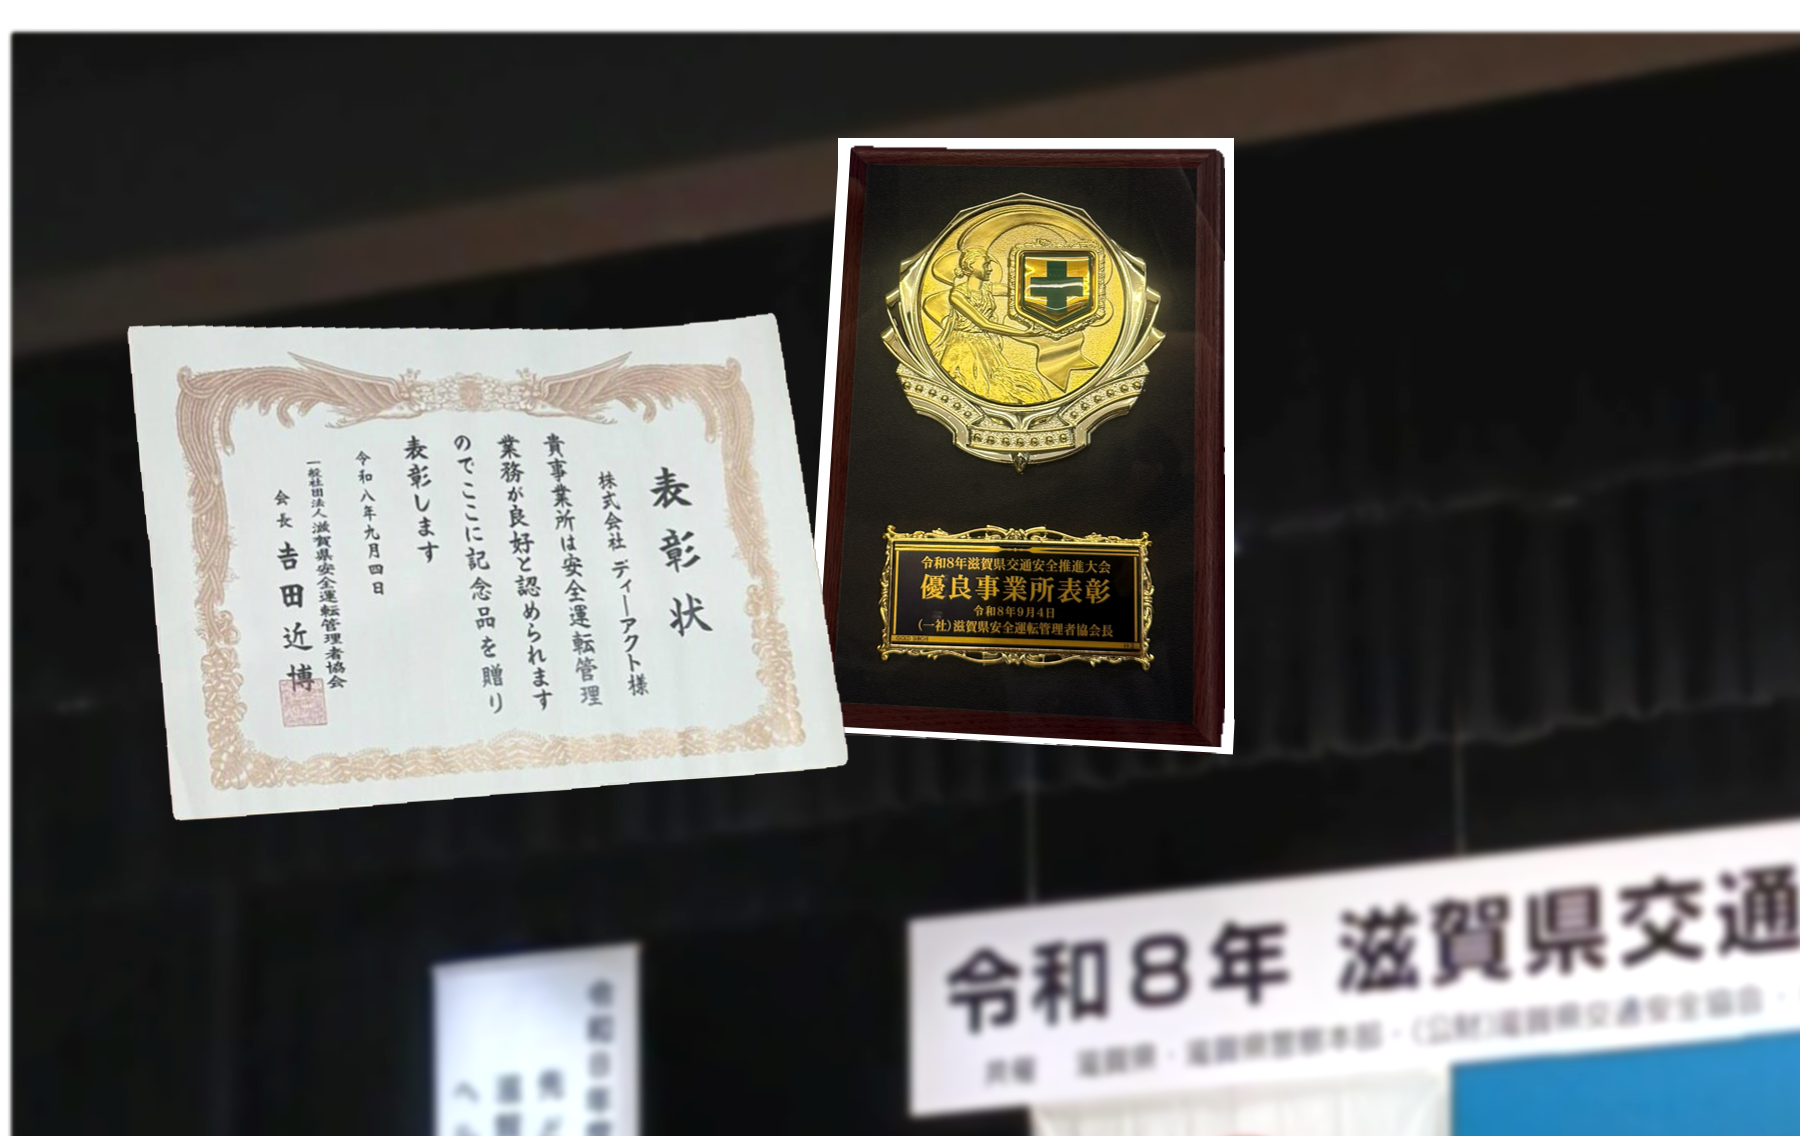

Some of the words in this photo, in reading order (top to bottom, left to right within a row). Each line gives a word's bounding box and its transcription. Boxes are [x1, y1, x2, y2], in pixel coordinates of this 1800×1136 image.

[273, 489, 293, 529] 会長
[355, 450, 385, 596] 令和八年九月四日
[403, 434, 440, 564] 表彰します
[598, 470, 627, 551] 株式会社
[650, 466, 714, 638] 表彰状
[453, 434, 505, 714] のでここに記念品を贈り
[496, 433, 554, 711] 業務が良好と認められます
[543, 432, 604, 707] 貴事業所は安全運転管理
[611, 558, 650, 697] ディーアクト様
[919, 573, 1112, 604] 優良事業所表彰
[920, 555, 1112, 575] 令和8年滋賀県交通安全推進大会
[972, 604, 1056, 619] 令和8年9月4日
[945, 920, 1290, 1036] 令和8年
